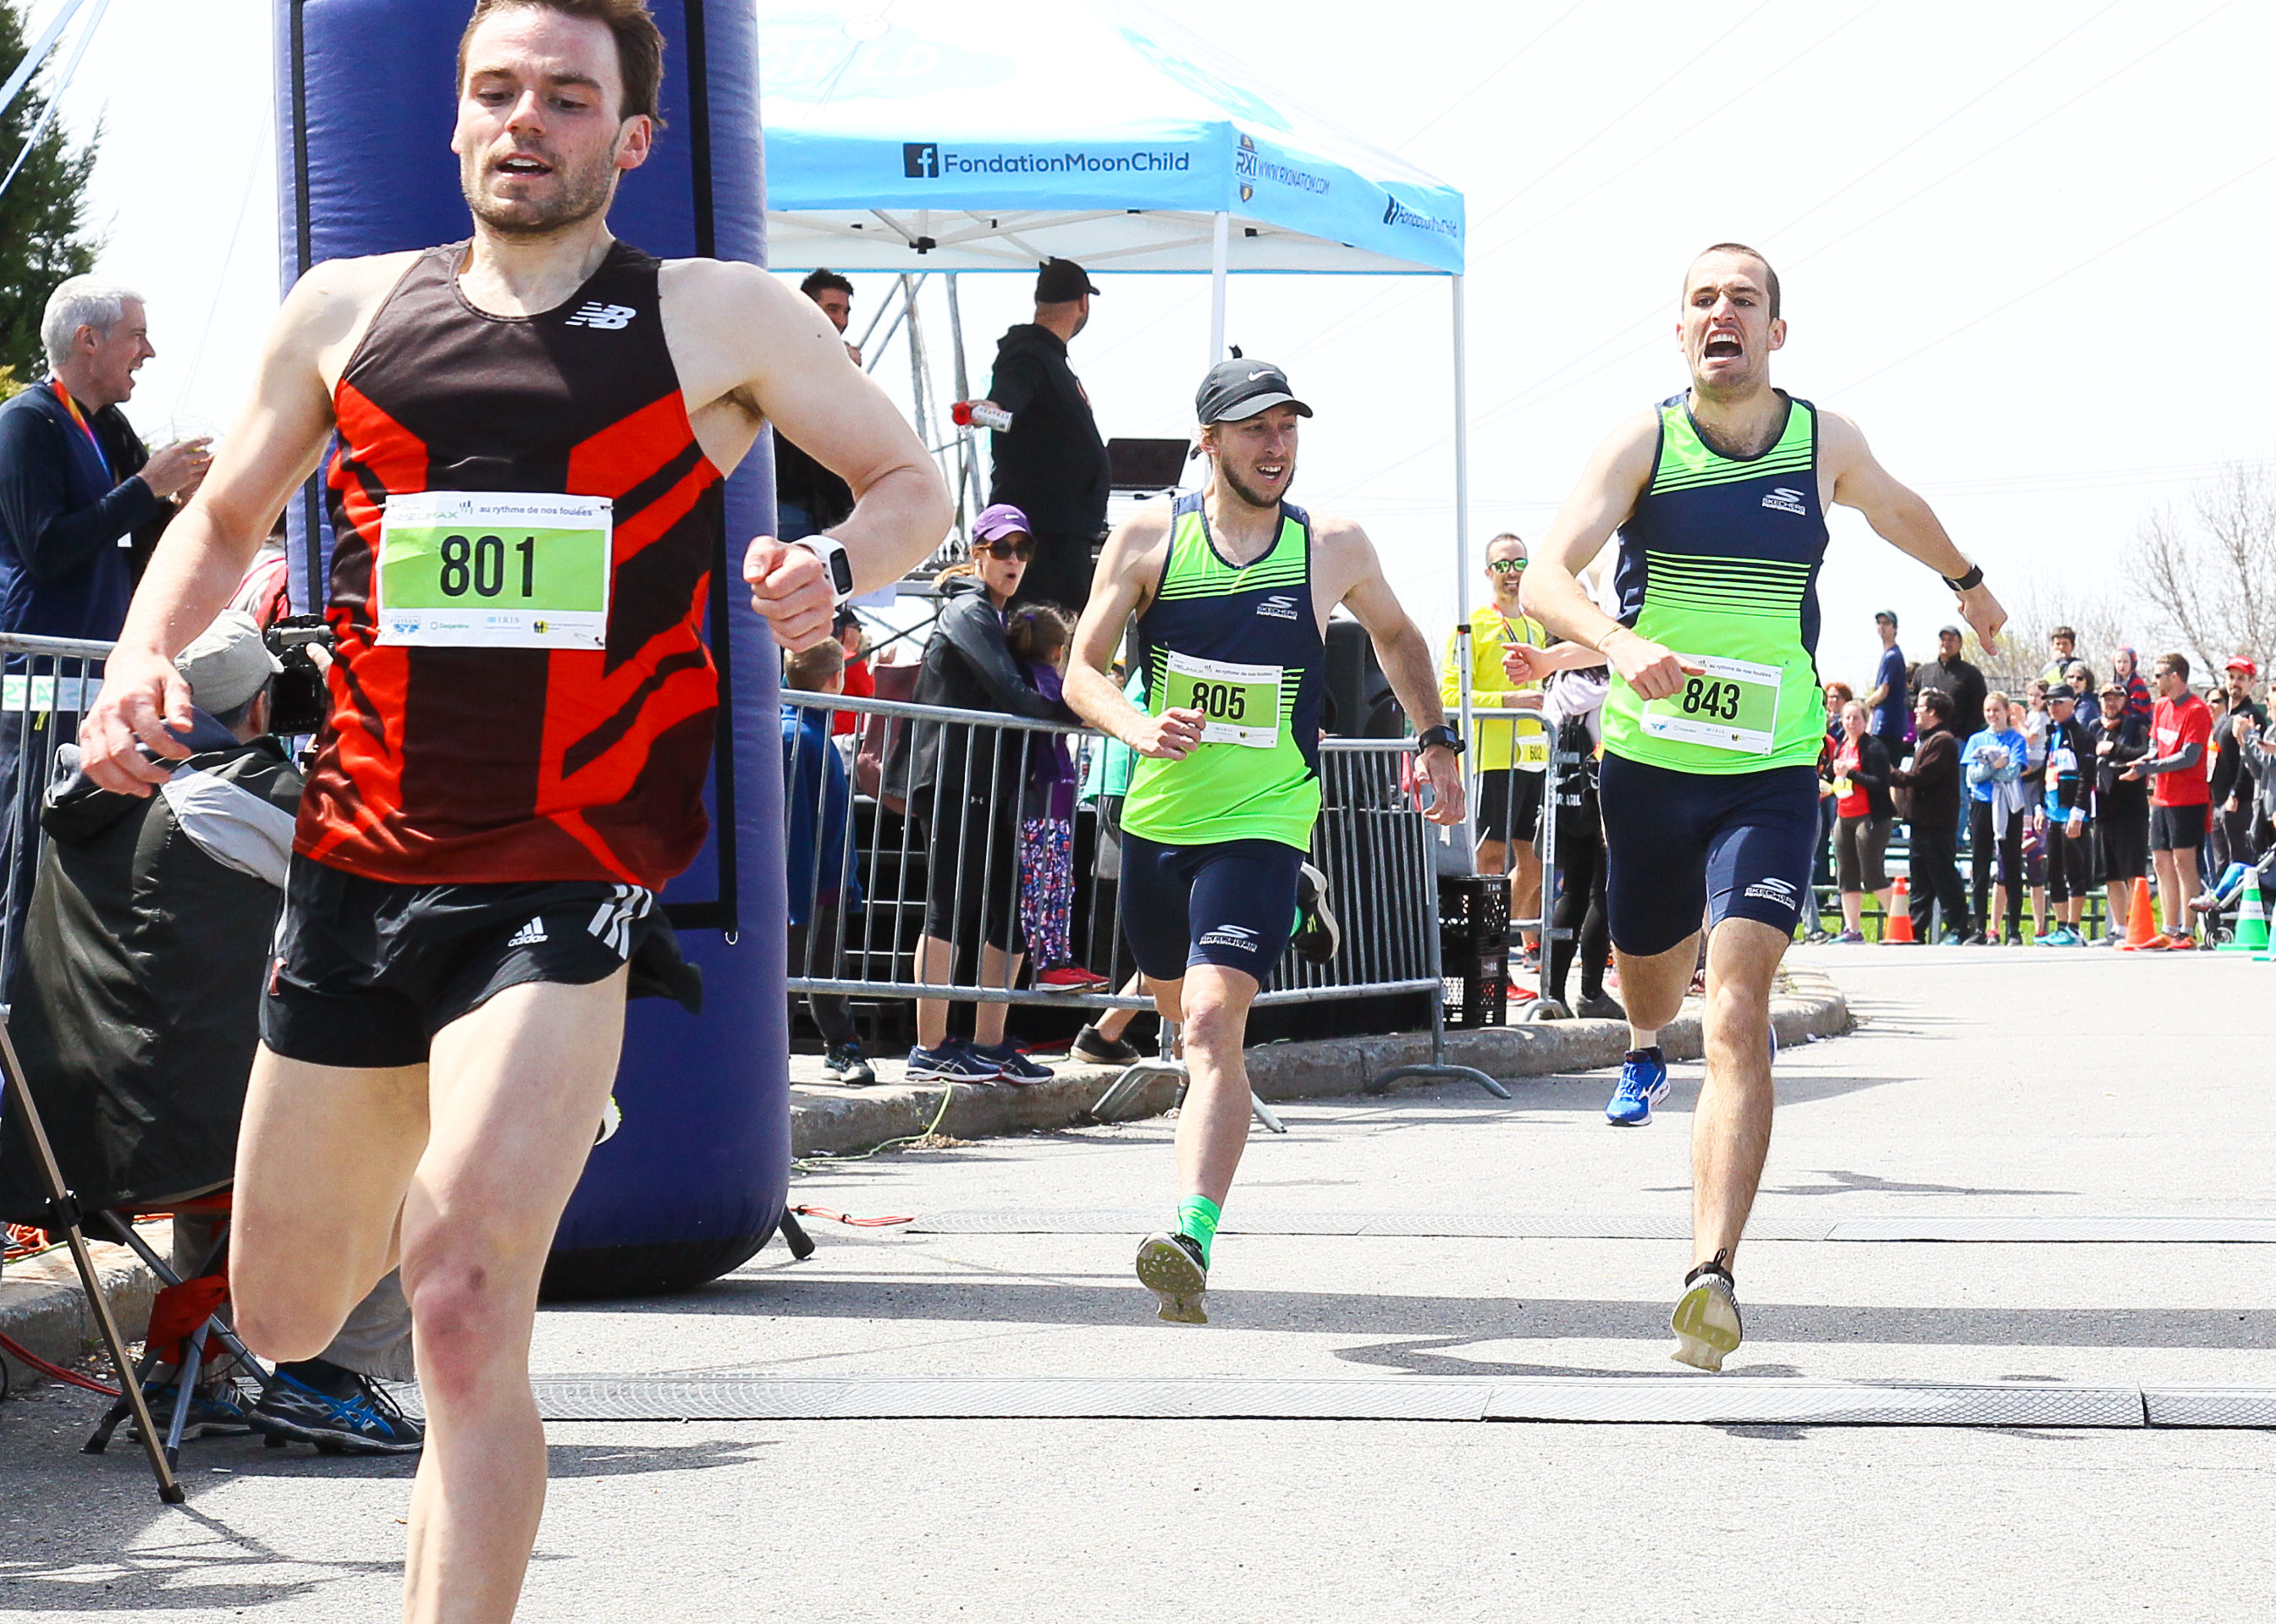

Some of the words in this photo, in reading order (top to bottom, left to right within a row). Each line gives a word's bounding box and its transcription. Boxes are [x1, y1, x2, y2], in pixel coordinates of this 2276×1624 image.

[944, 151, 1190, 173] FondationMoonChild
[493, 504, 525, 515] rythme
[527, 505, 538, 514] de
[439, 534, 535, 597] 801
[1191, 682, 1246, 720] 805
[1683, 678, 1740, 720] 843
[508, 933, 548, 947] adidas
